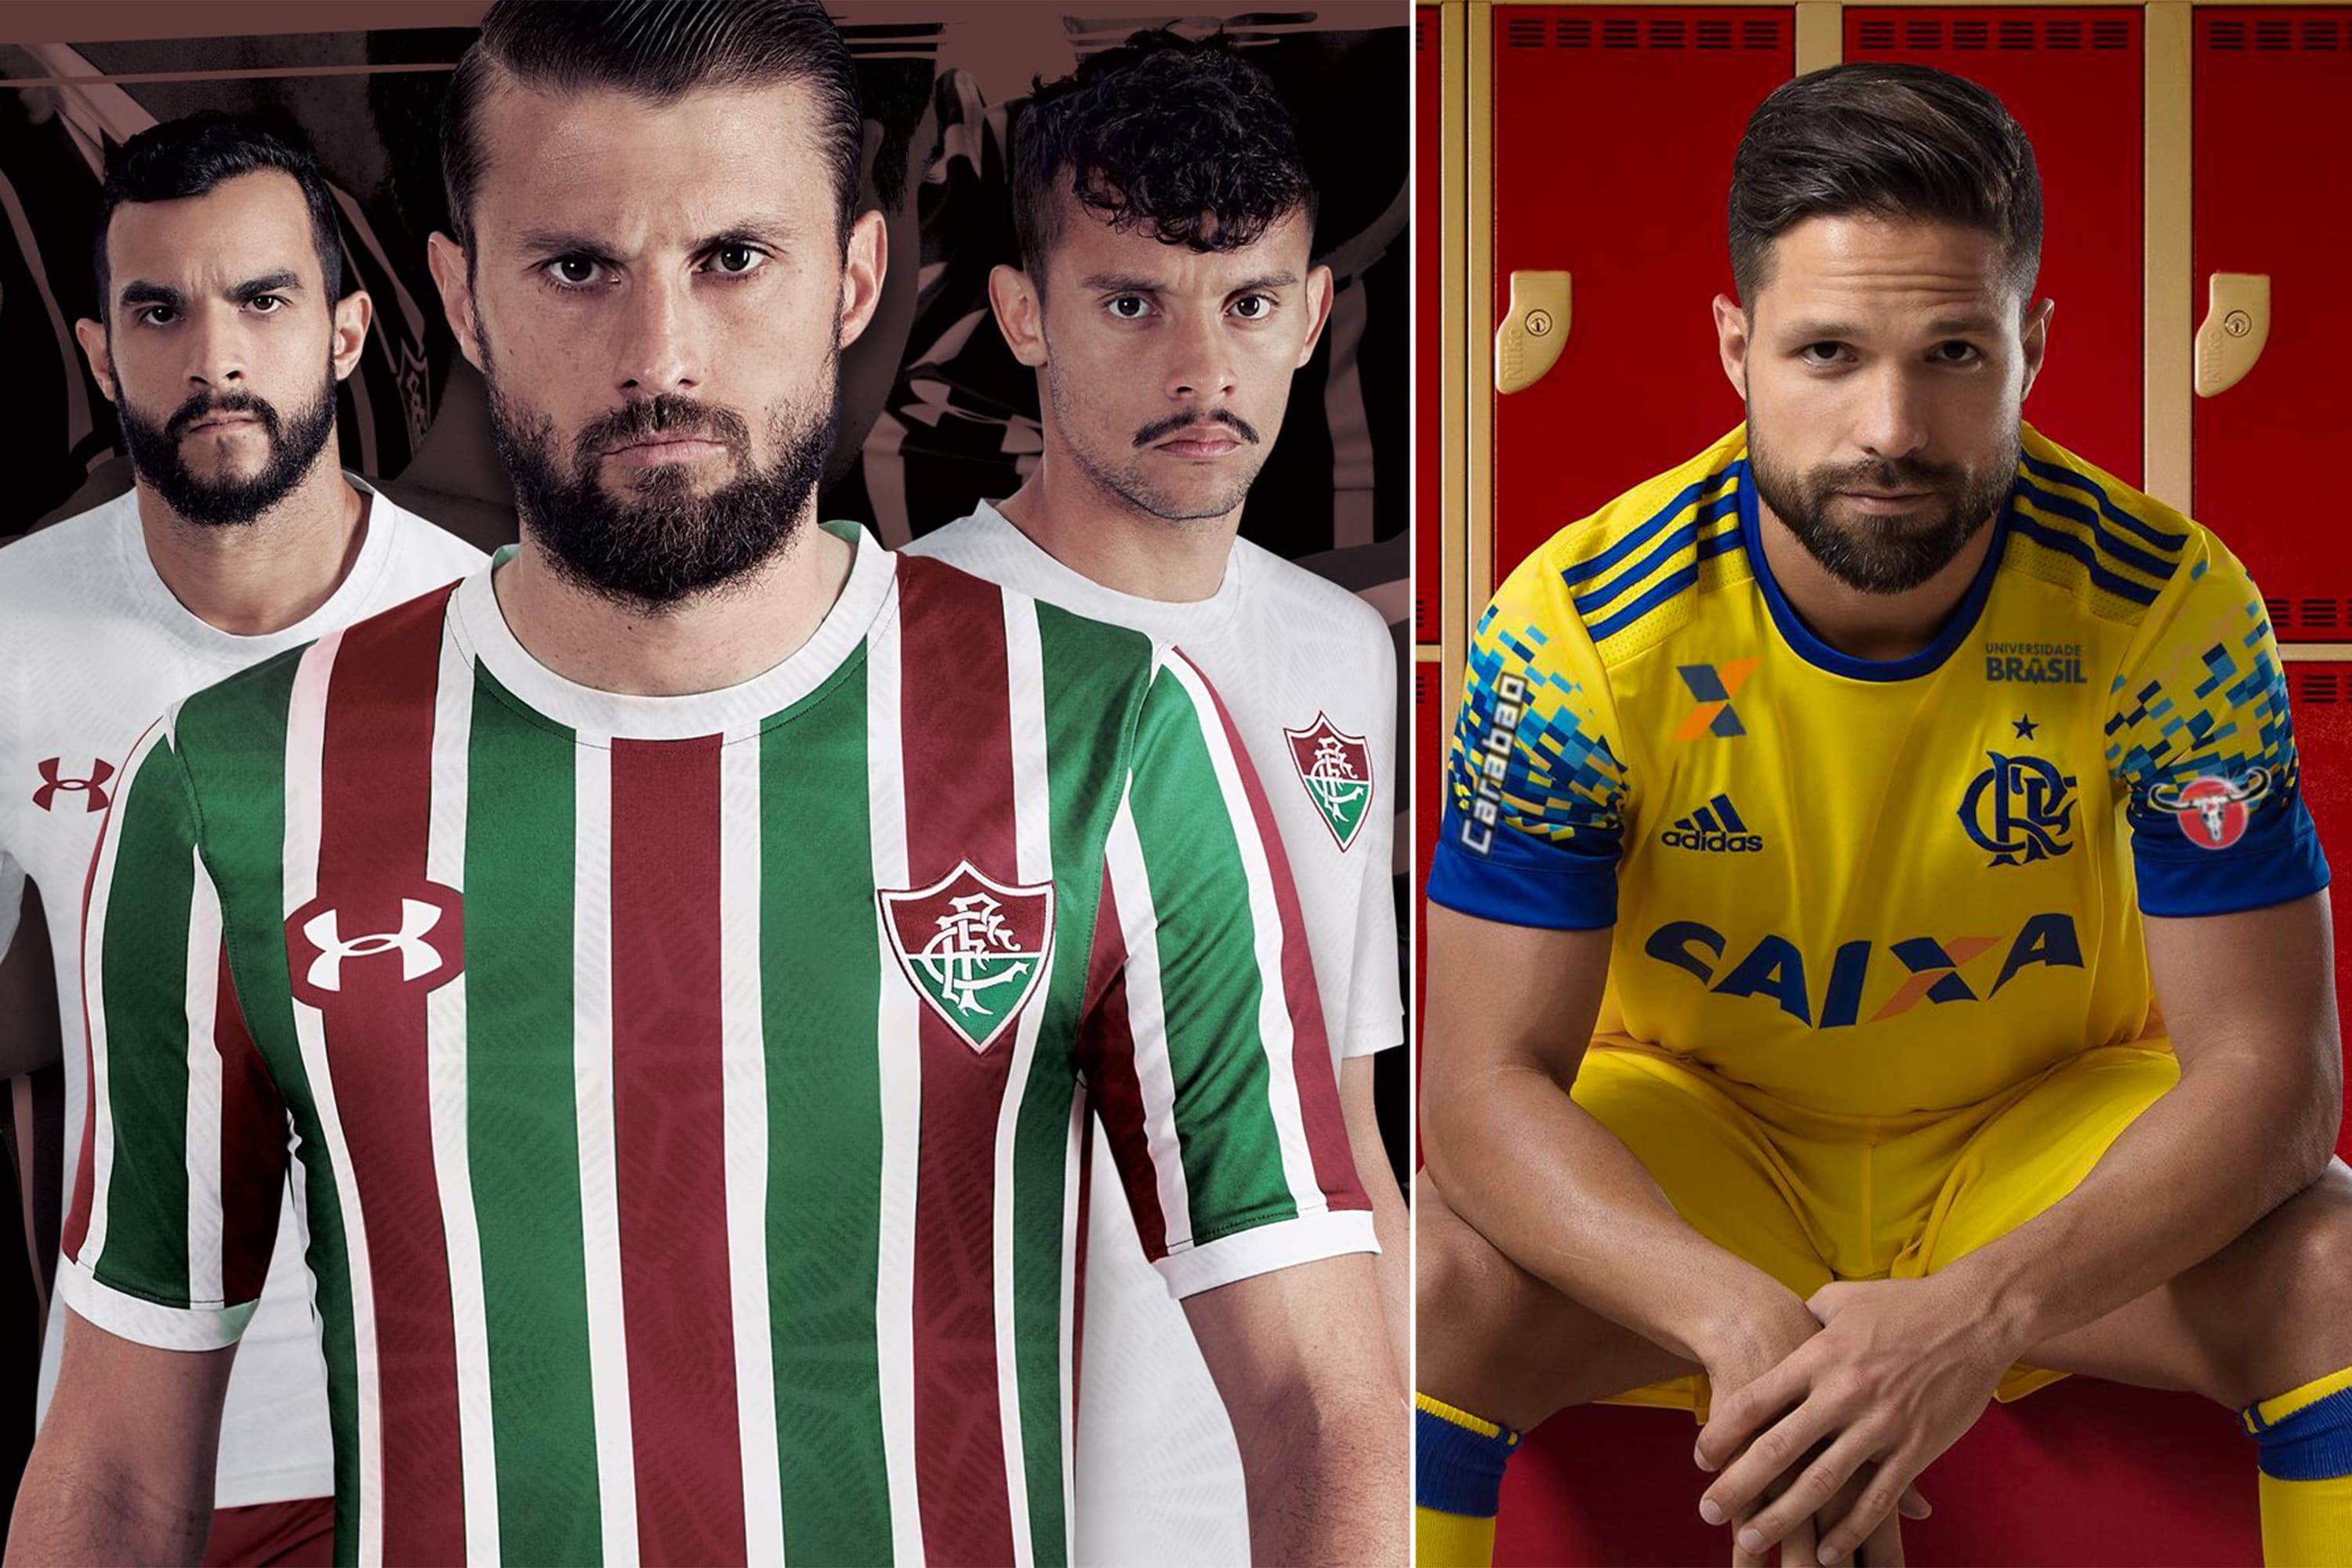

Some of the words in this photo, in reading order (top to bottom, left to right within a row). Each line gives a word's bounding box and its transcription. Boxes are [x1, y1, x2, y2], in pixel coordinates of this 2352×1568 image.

[1985, 642, 2082, 655] UNIVERSIDADE
[1986, 656, 2087, 684] BRASIL
[1661, 830, 1763, 853] adidas
[1645, 913, 2085, 1029] CAIXA
